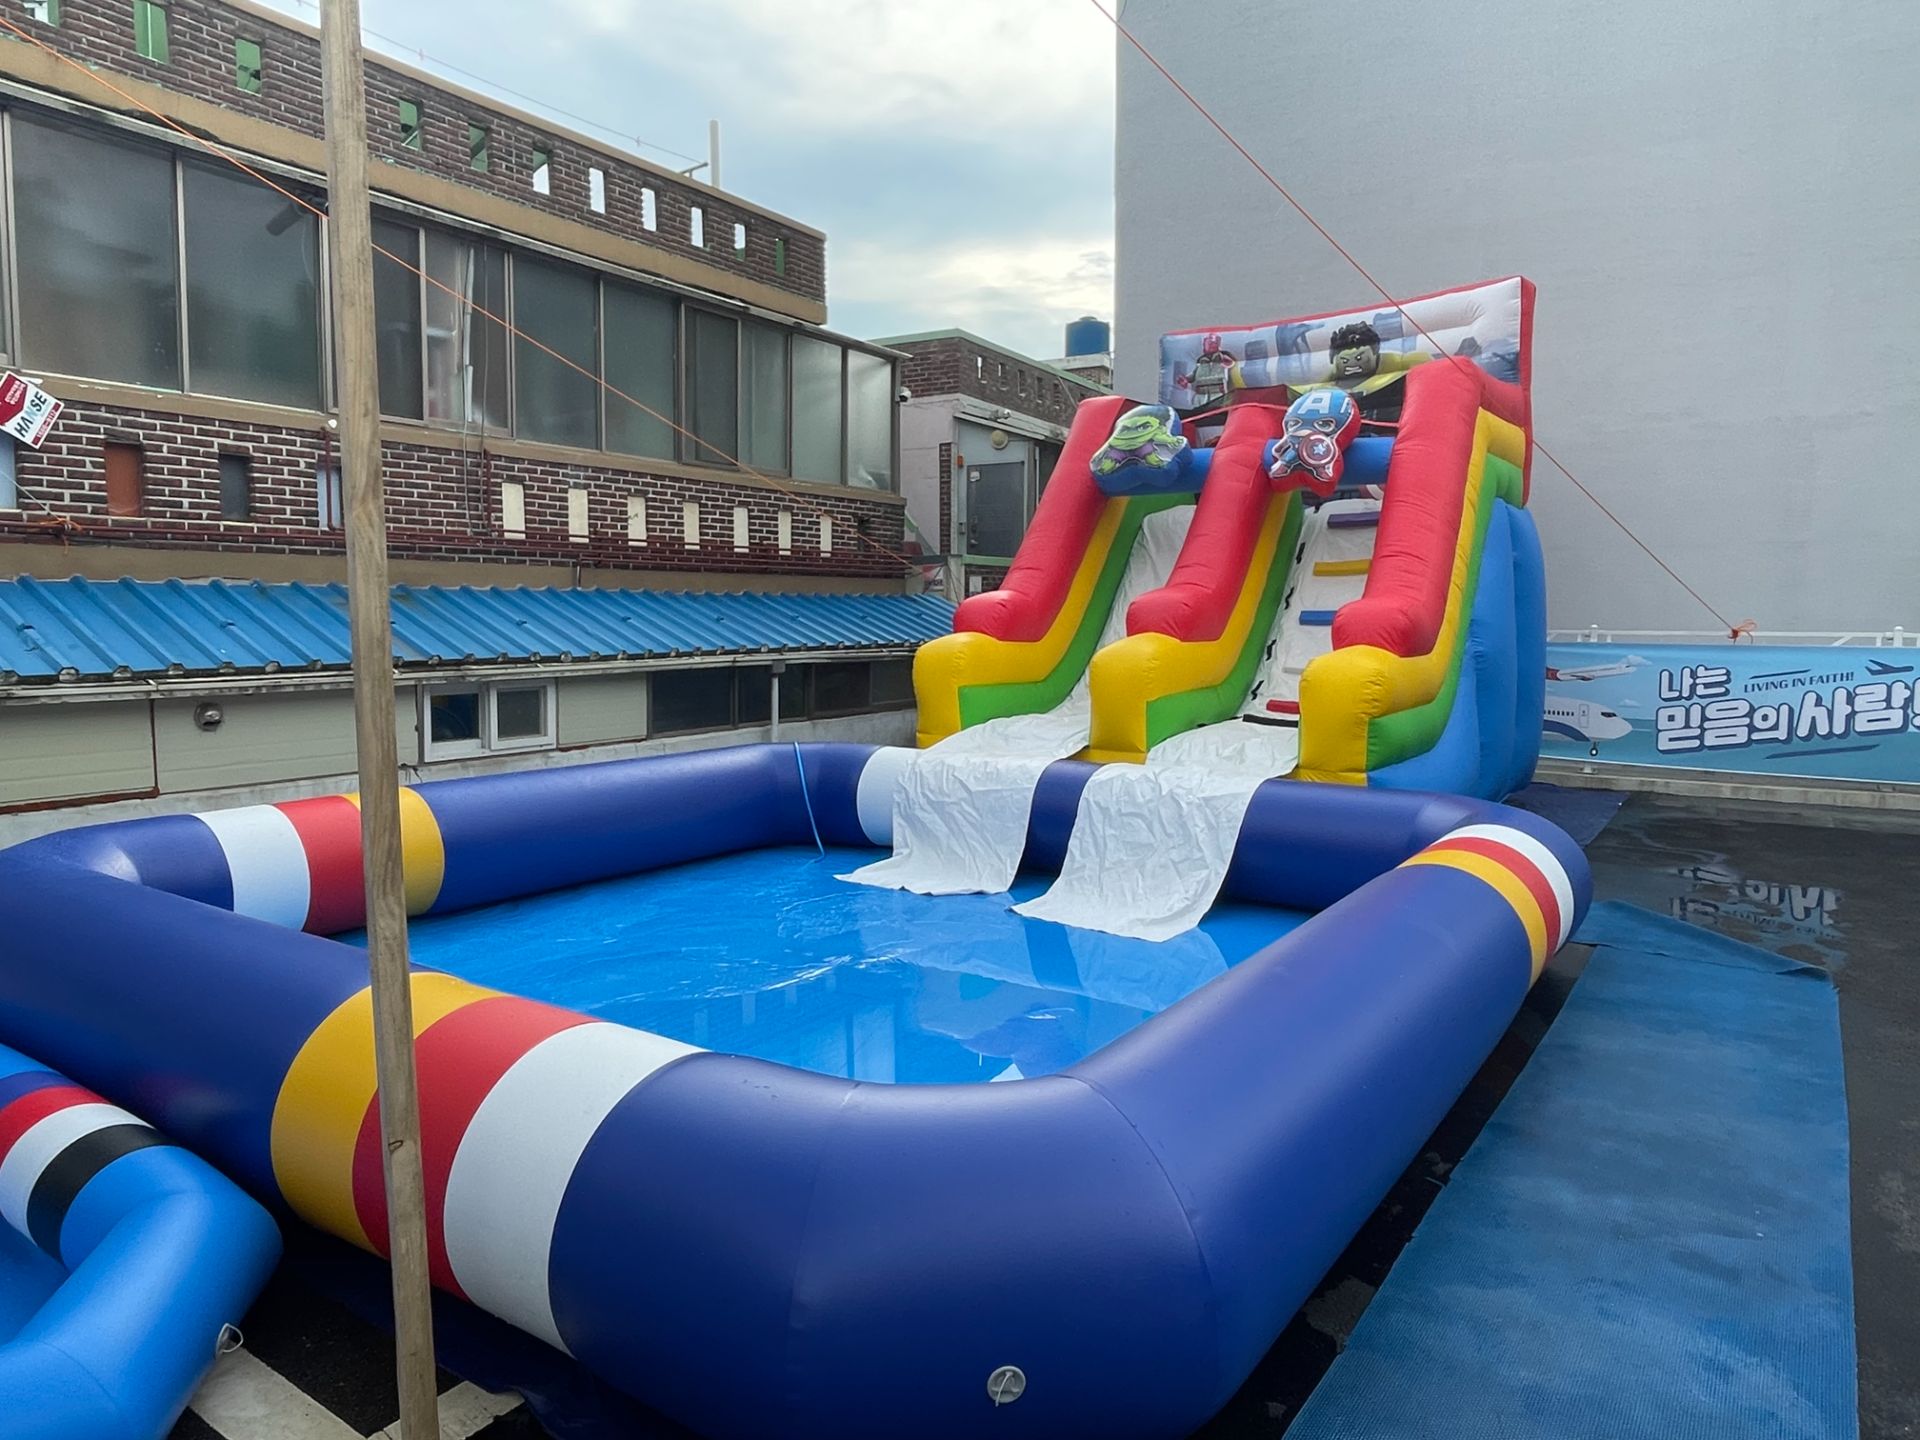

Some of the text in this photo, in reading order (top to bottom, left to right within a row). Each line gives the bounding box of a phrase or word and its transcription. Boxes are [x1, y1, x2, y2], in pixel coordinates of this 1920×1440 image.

[1297, 391, 1332, 414] A
[1658, 665, 1730, 700] 나는
[1744, 672, 1854, 693] LIVING IN FAITH!
[1656, 699, 1792, 753] 믿음의
